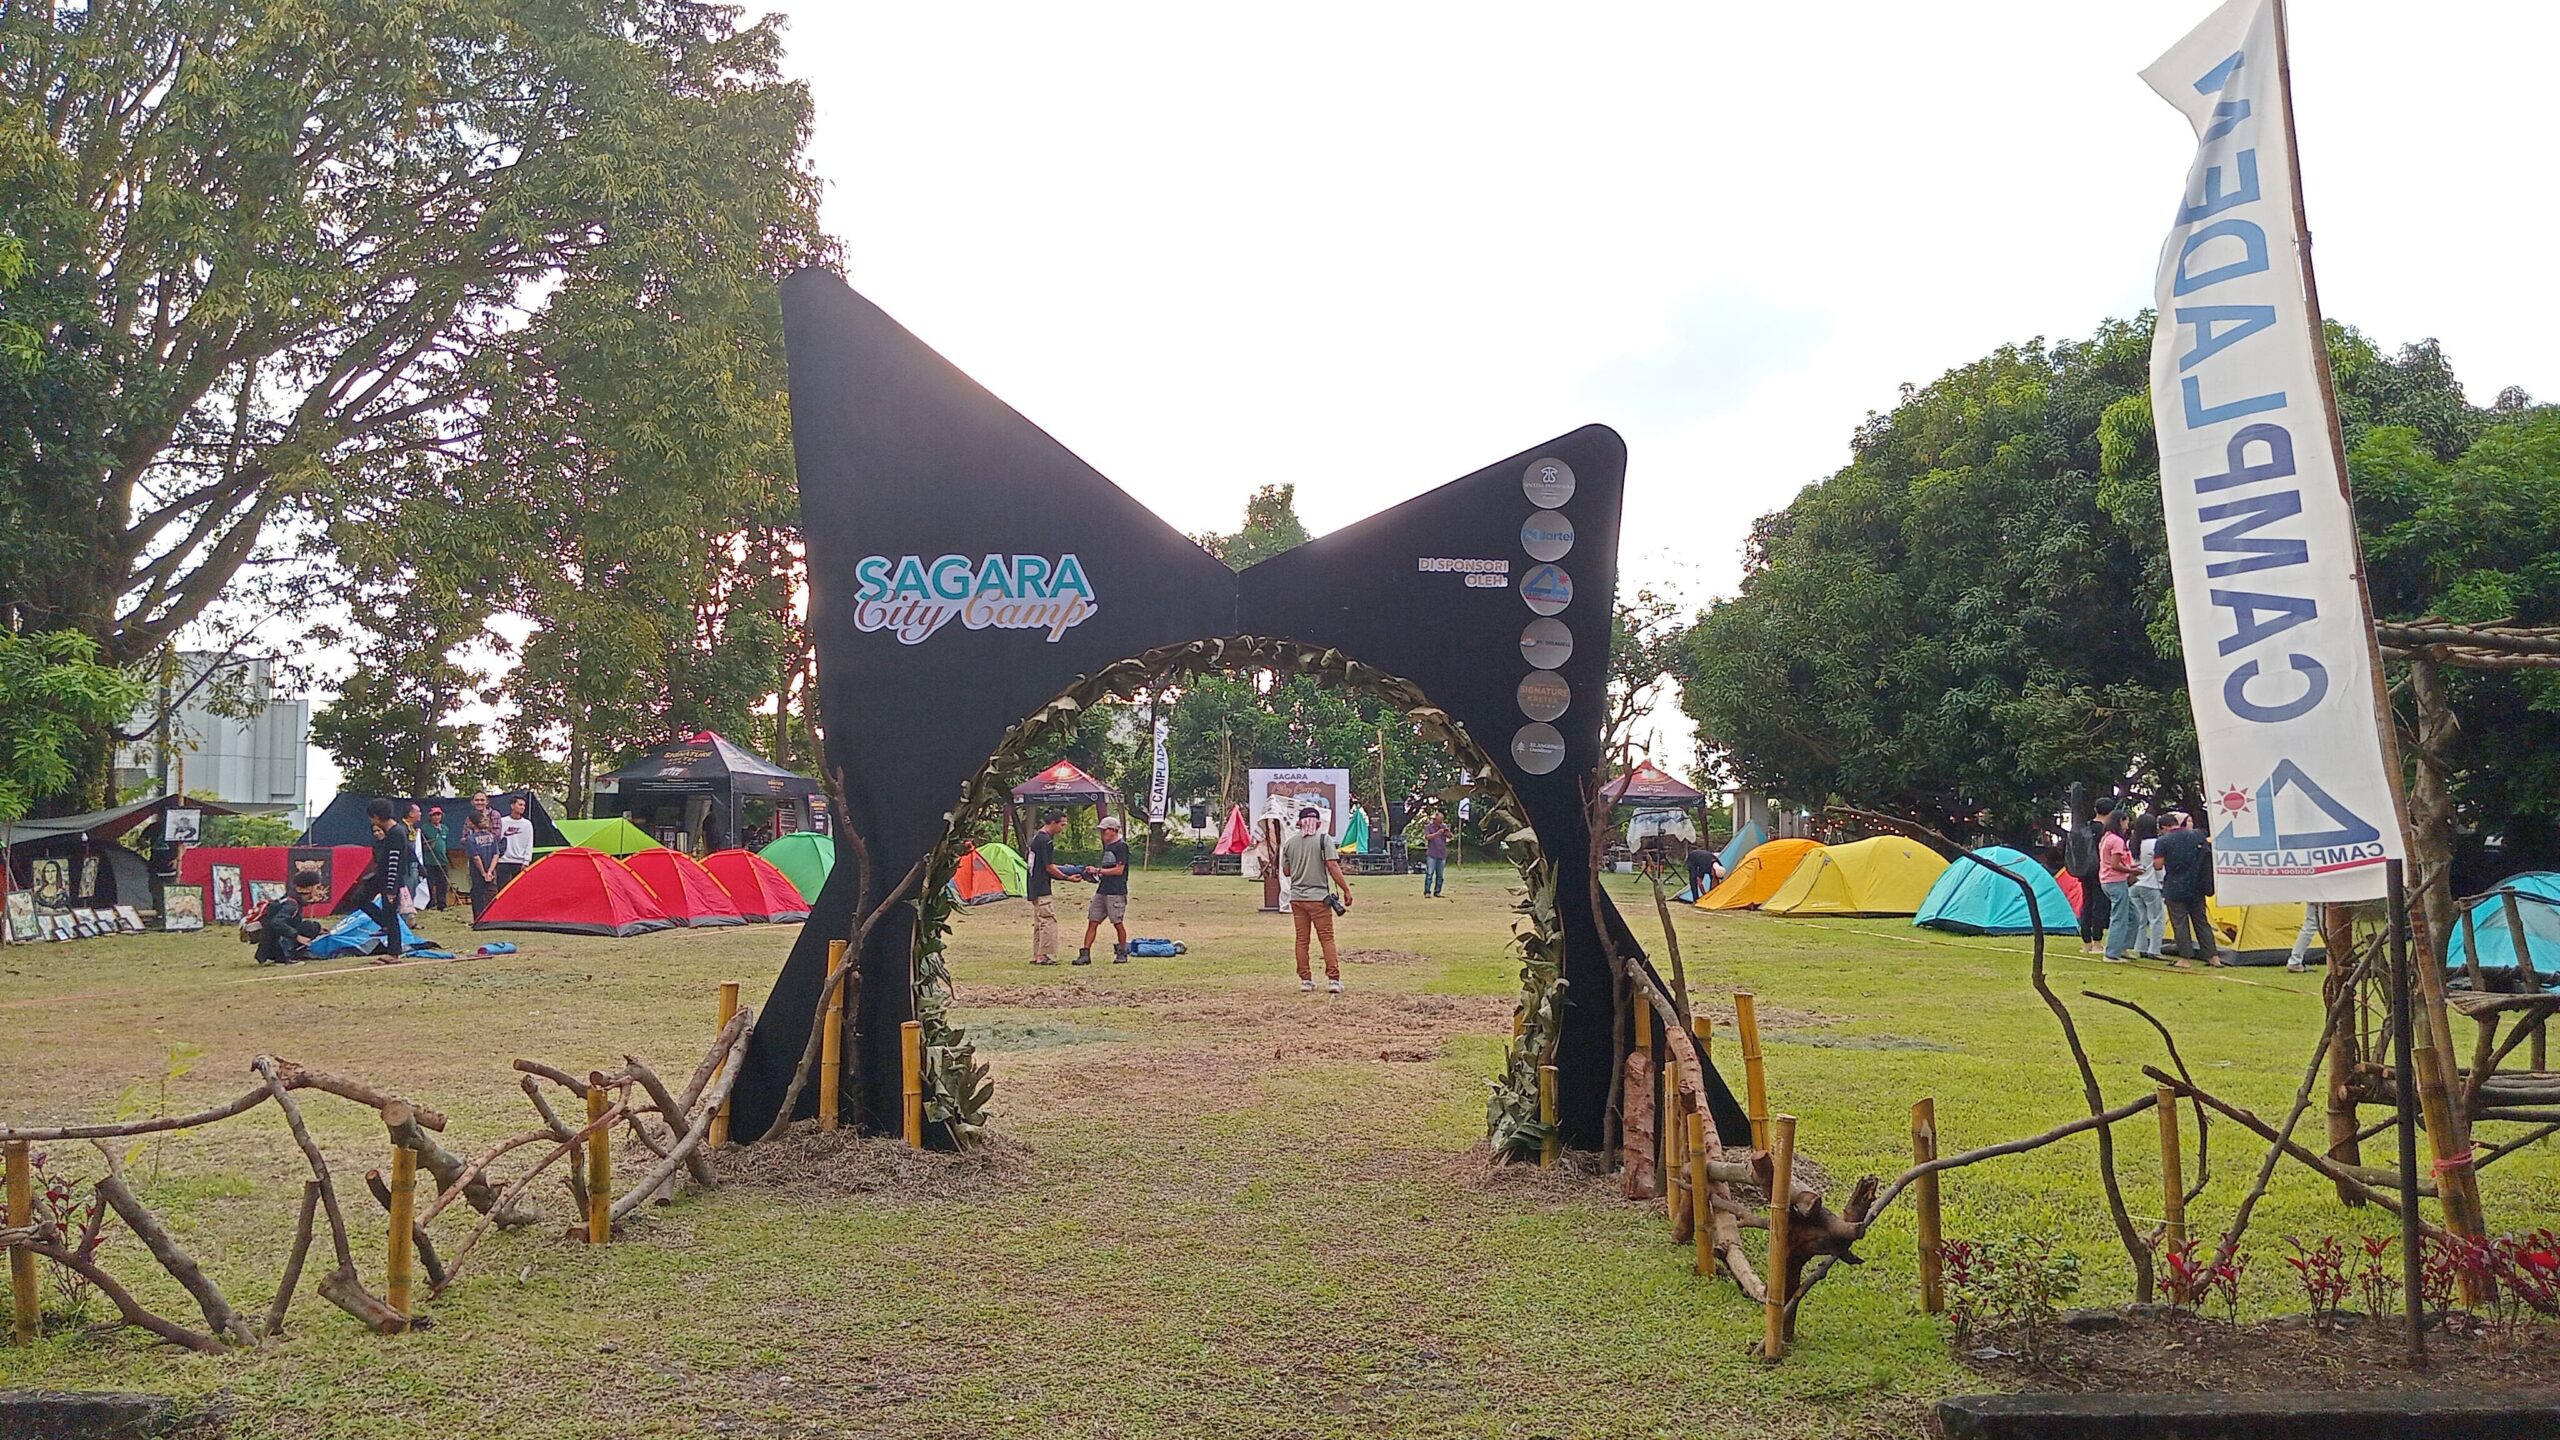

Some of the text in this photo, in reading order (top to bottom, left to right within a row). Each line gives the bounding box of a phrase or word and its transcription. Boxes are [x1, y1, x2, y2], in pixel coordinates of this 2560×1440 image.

[859, 556, 1090, 601] SAGARA
[1437, 559, 1509, 573] SPONSORI
[857, 586, 1093, 641] City Camp
[1519, 685, 1569, 697] SIGNATURE
